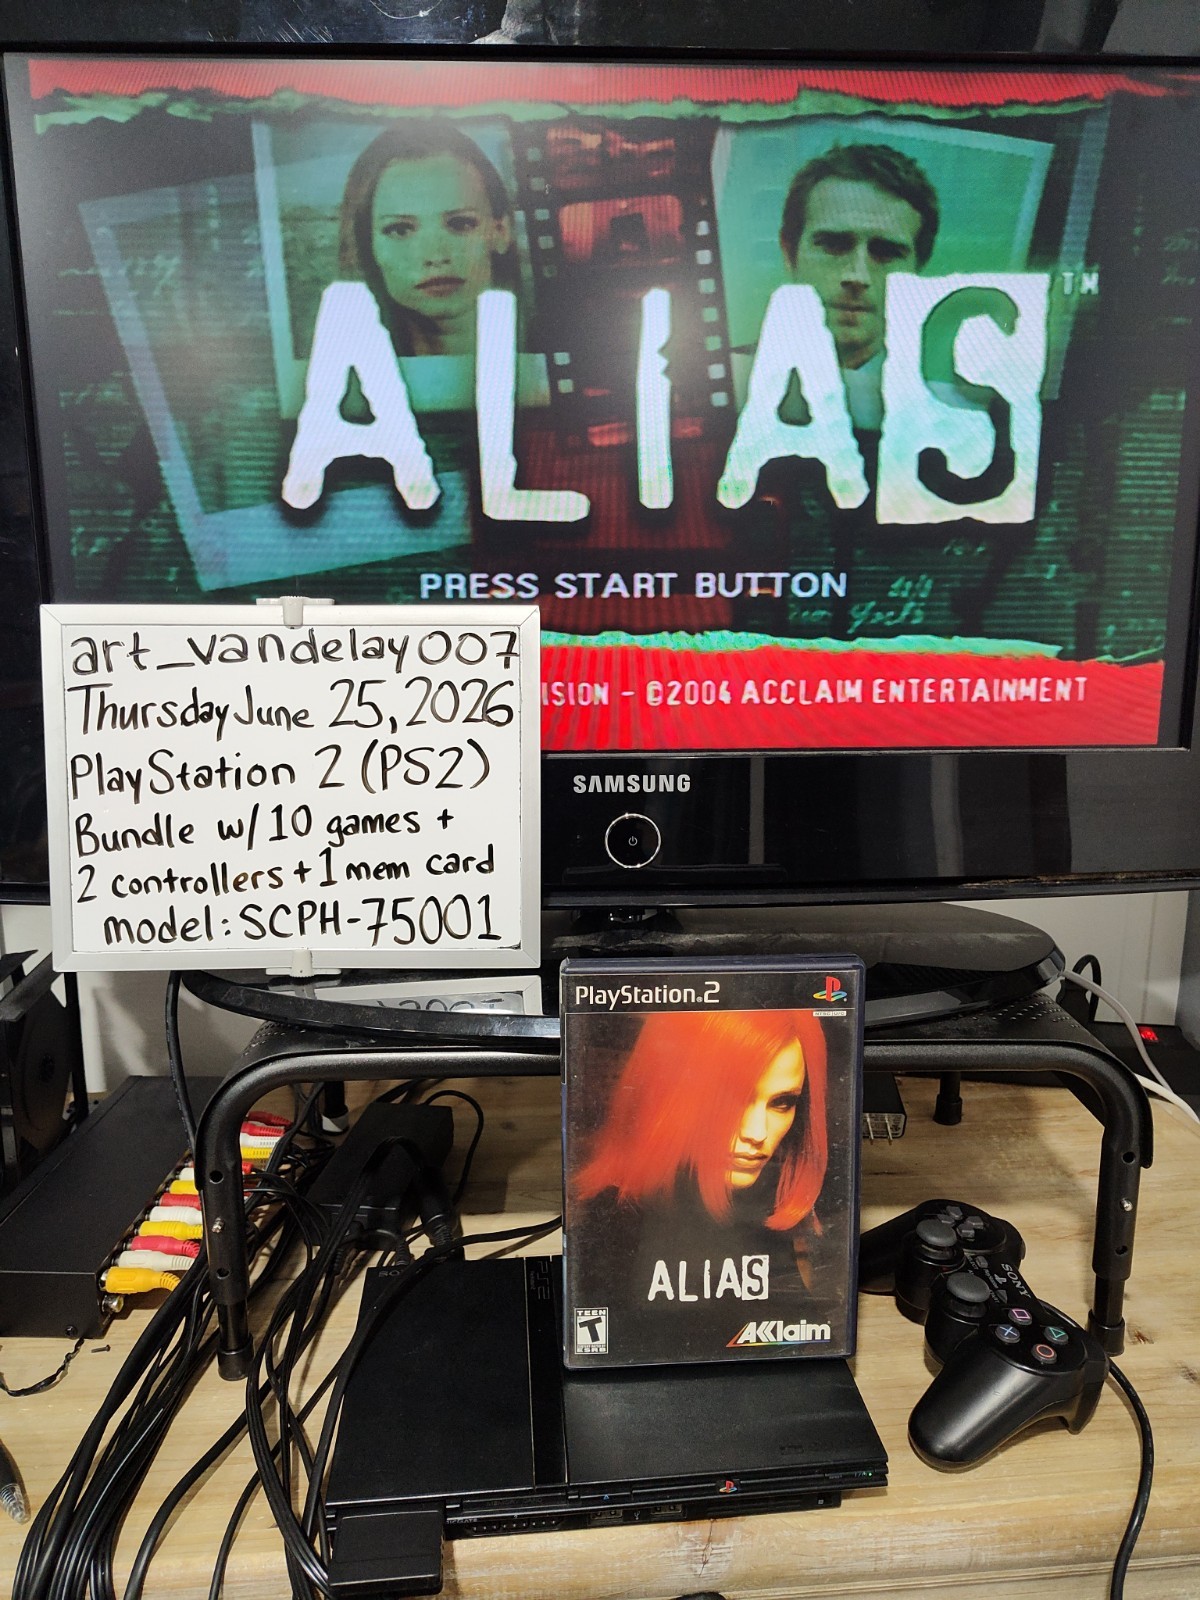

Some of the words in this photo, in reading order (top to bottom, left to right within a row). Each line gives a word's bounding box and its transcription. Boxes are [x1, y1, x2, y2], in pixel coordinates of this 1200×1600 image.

[281, 272, 1050, 525] ALIAS
[420, 573, 539, 599] PRESS
[555, 573, 678, 599] START
[695, 572, 848, 599] BUTTON
[67, 684, 230, 741] Thursday
[234, 685, 315, 731] June
[741, 678, 863, 706] ACCLAIM
[873, 676, 1088, 704] ENTERTAINMENT
[71, 749, 296, 805] PlayStation
[315, 745, 345, 789] 2
[362, 739, 490, 794] (PS2)
[573, 774, 691, 794] SAMSUNG
[76, 812, 195, 857] Bundle
[327, 811, 421, 848] games
[77, 865, 97, 904] 2
[346, 862, 410, 881] mem
[426, 844, 494, 876] card
[240, 894, 502, 947] SCPH-75001
[648, 1255, 769, 1302] ALIAS
[1000, 1263, 1032, 1299] SONY
[578, 1317, 603, 1343] T
